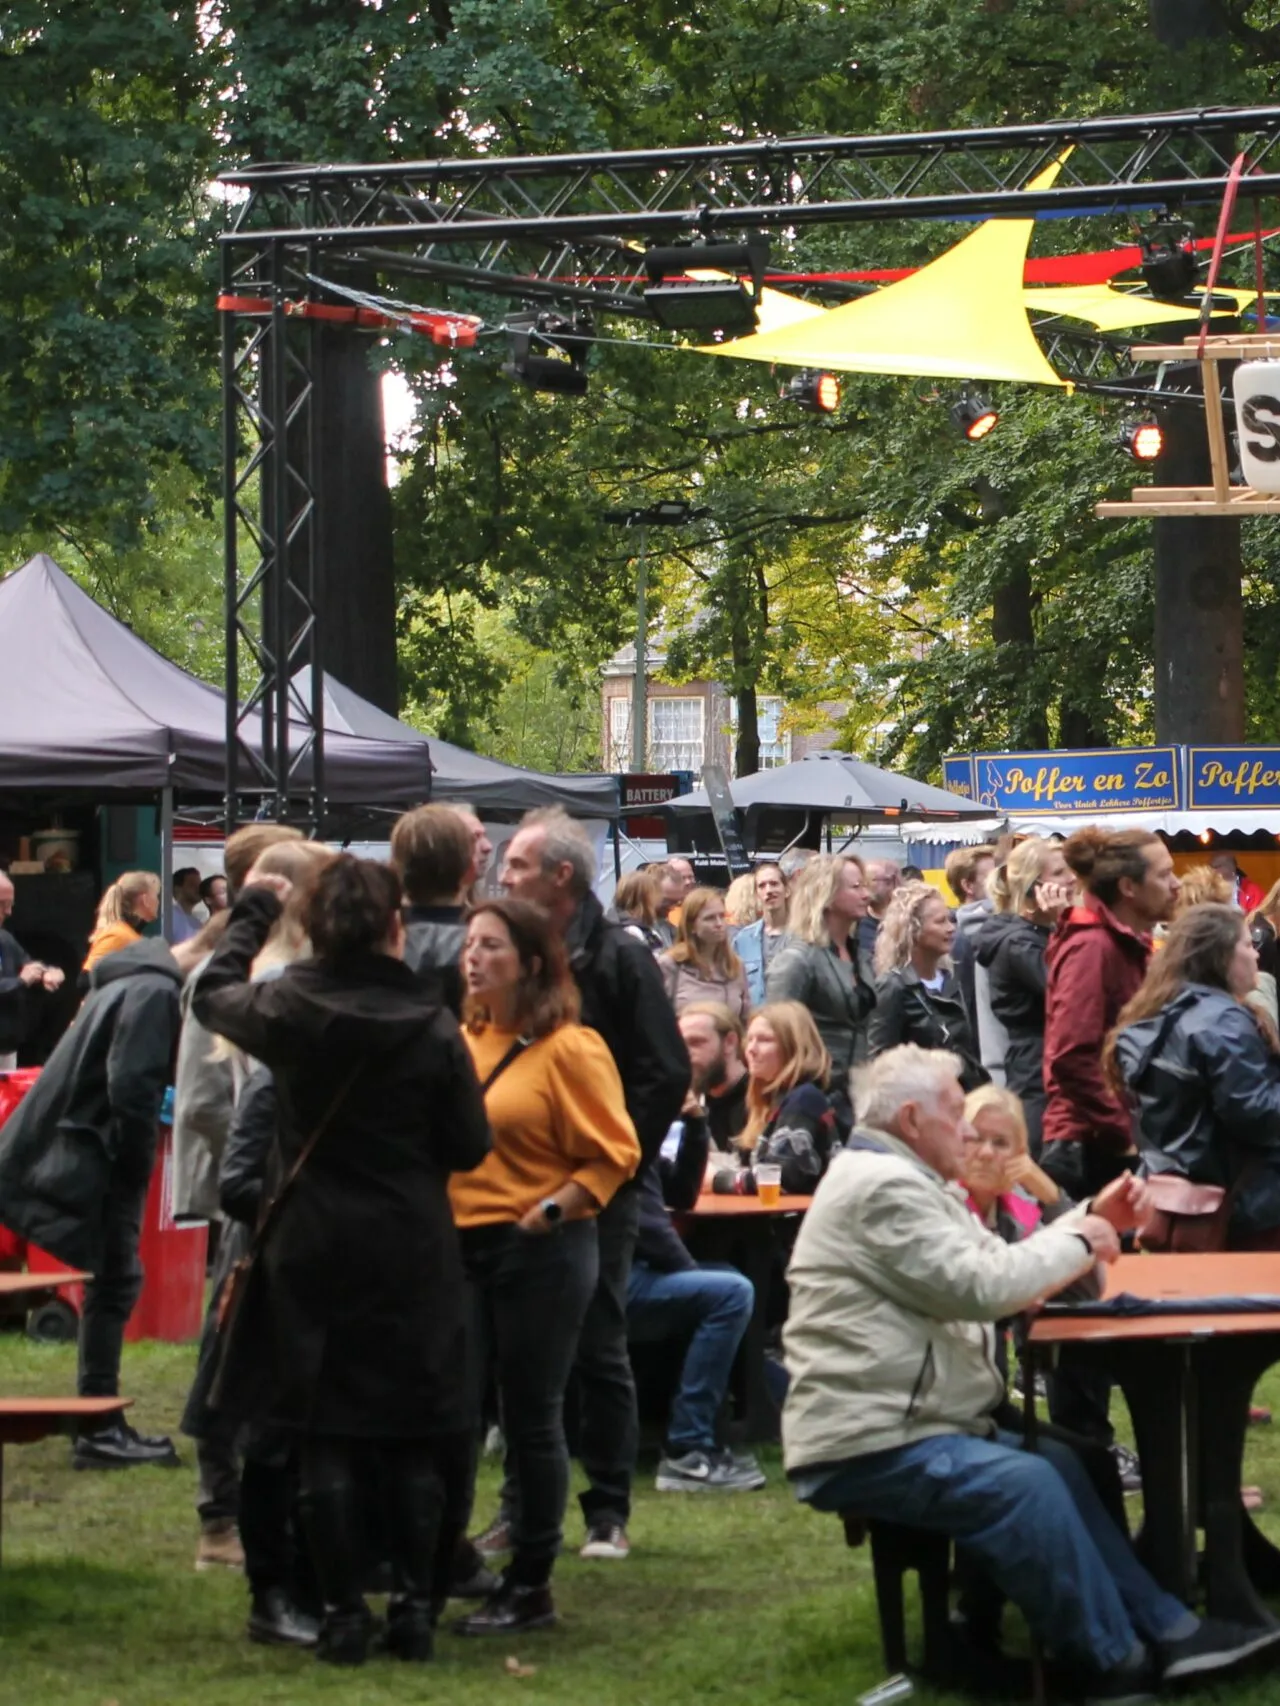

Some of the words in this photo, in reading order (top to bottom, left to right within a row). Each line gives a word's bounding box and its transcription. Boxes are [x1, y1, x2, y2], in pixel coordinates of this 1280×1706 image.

[1004, 766, 1087, 801] Poffer
[1093, 773, 1126, 790] en
[1134, 761, 1172, 789] Zo
[626, 788, 675, 802] BATTERY
